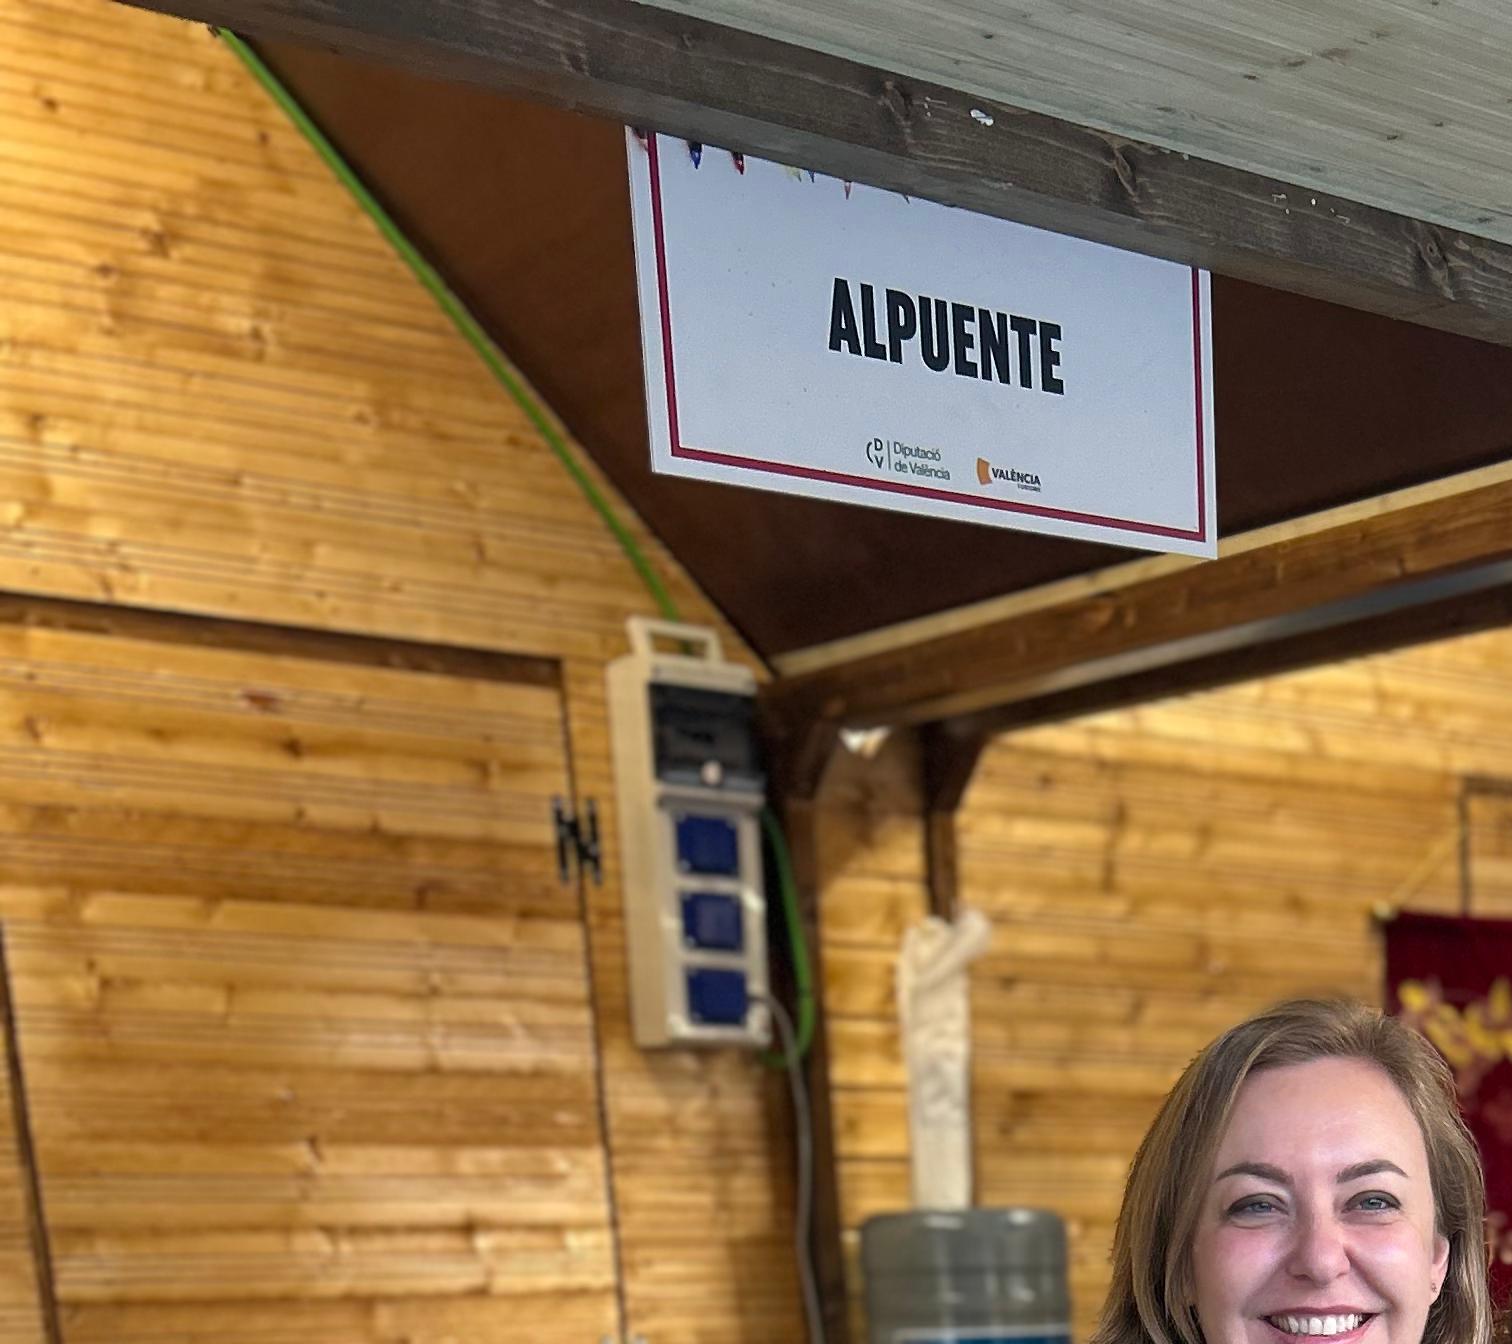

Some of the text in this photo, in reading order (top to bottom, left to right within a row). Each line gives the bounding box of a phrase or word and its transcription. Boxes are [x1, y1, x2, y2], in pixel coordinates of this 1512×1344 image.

[828, 277, 1064, 395] ALPUENTE
[893, 441, 941, 461] Diputació
[894, 460, 909, 473] de
[991, 467, 1041, 487] VALÈNCIA
